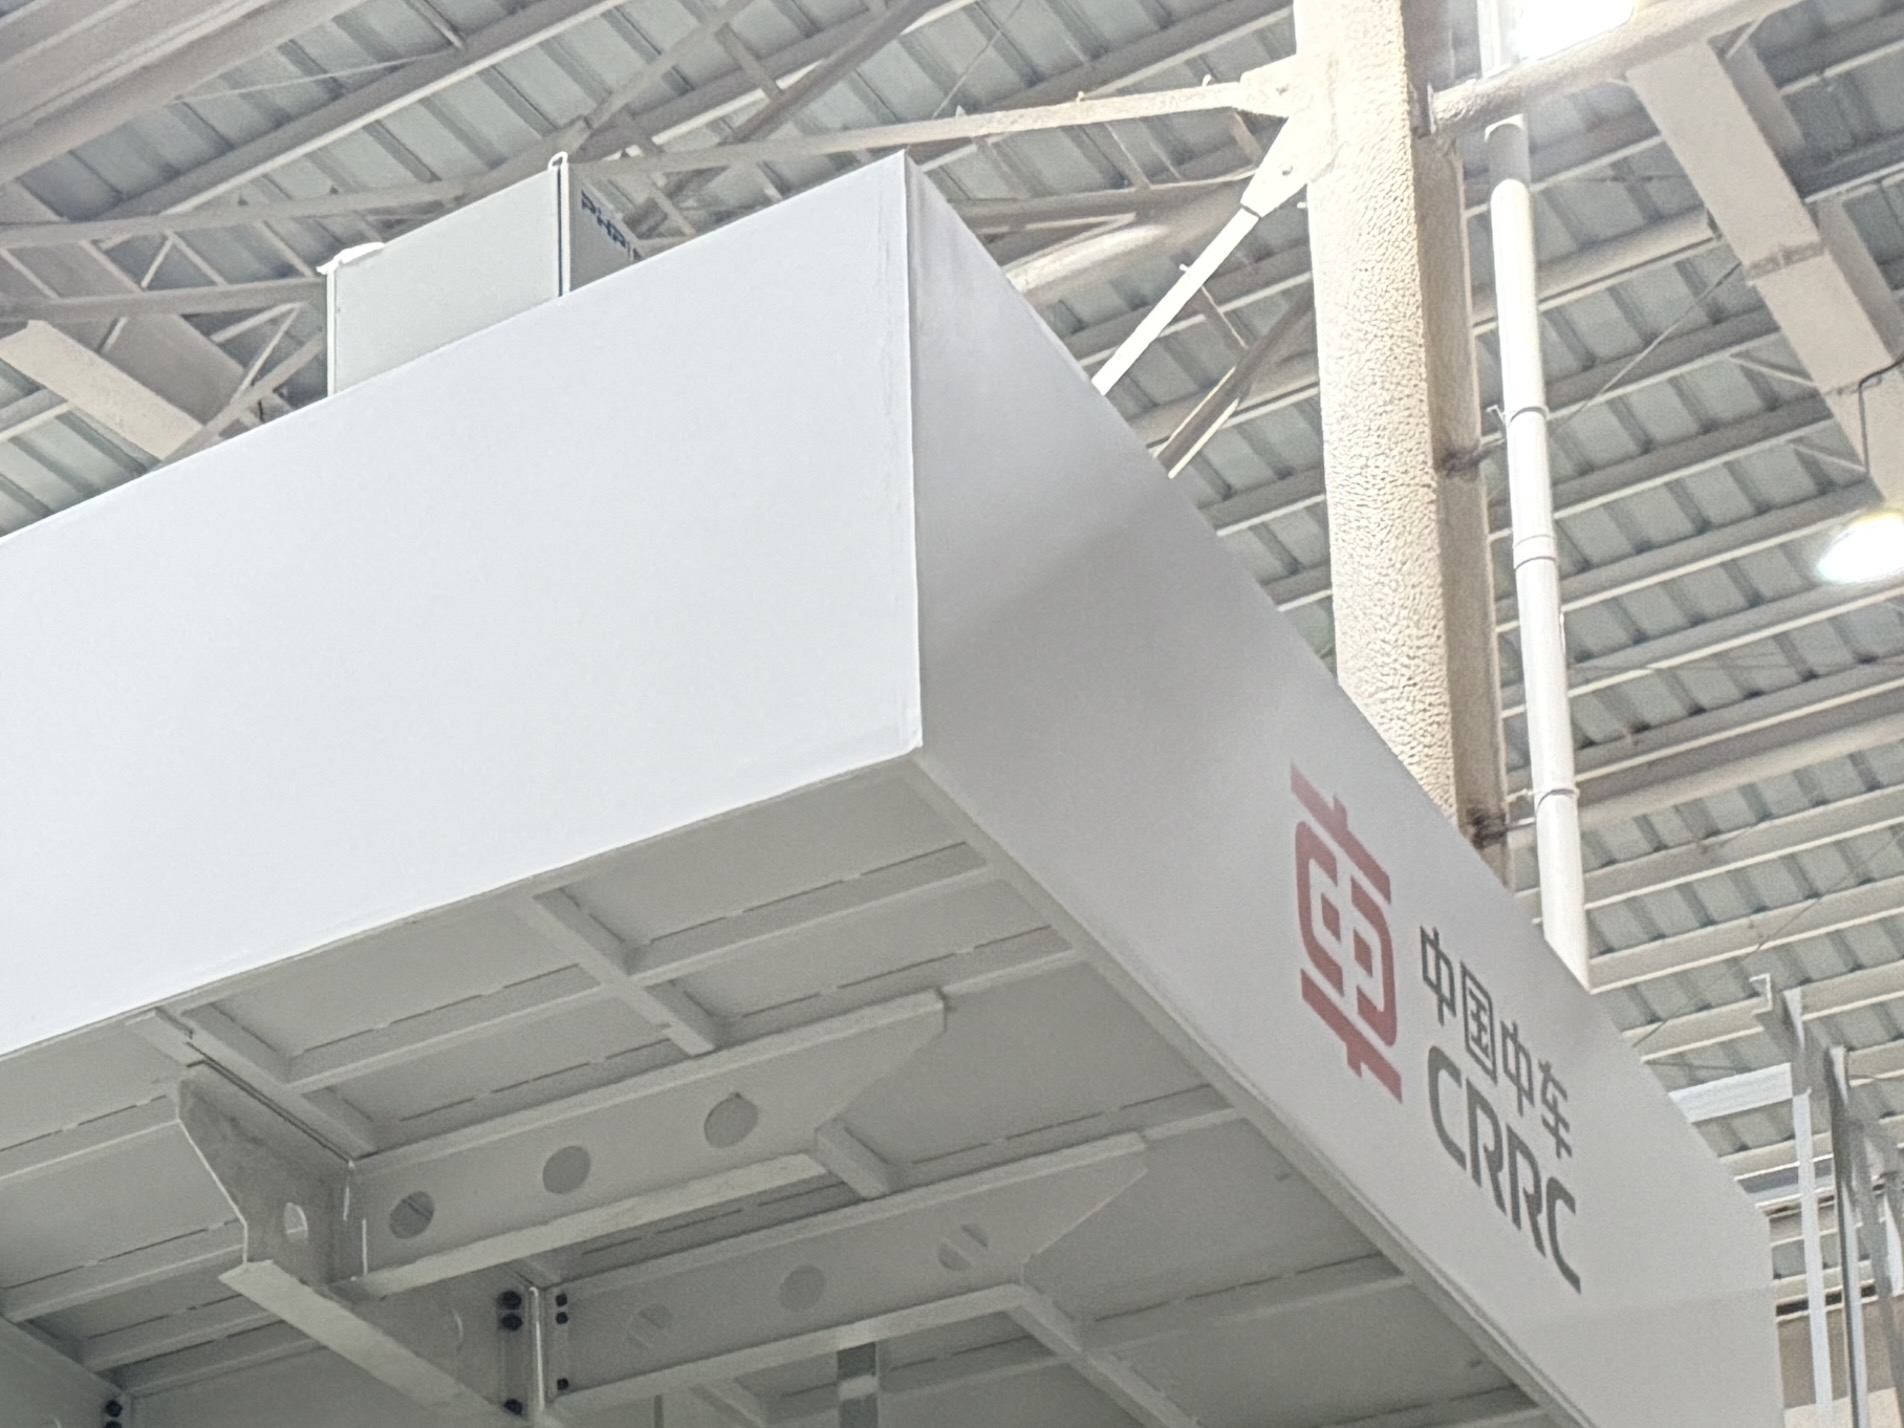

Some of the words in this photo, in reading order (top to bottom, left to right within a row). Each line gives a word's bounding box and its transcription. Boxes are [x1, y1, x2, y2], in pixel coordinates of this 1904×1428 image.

[1419, 925, 1573, 1160] 中国中车
[1427, 1045, 1582, 1295] CRRC
